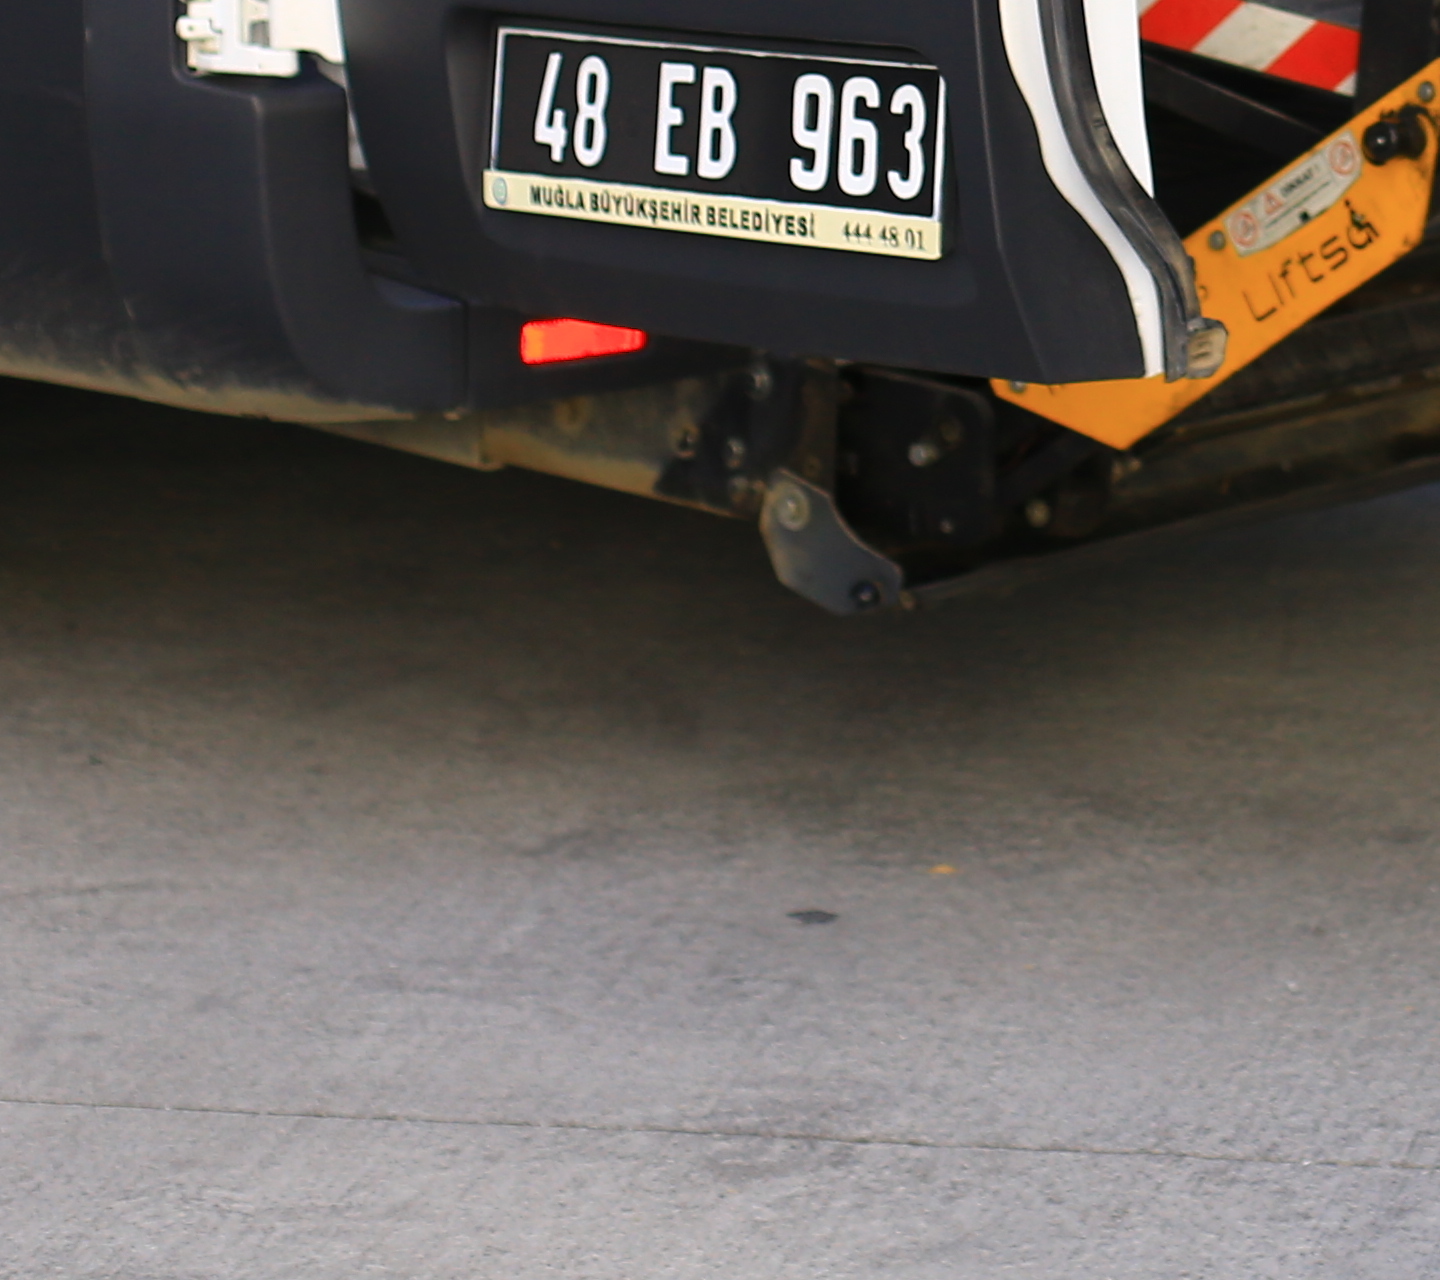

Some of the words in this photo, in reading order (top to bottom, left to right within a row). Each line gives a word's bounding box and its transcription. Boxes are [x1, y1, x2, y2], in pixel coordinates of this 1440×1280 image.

[533, 52, 610, 167] 48
[654, 60, 738, 180] EB
[788, 72, 927, 201] 963
[529, 184, 586, 211] MUĞLA
[590, 190, 701, 226] BÜYÜKŞEHİR
[706, 206, 815, 238] BELEDİYESİ
[842, 220, 872, 244] 444
[878, 225, 900, 248] 48
[905, 228, 926, 251] 01
